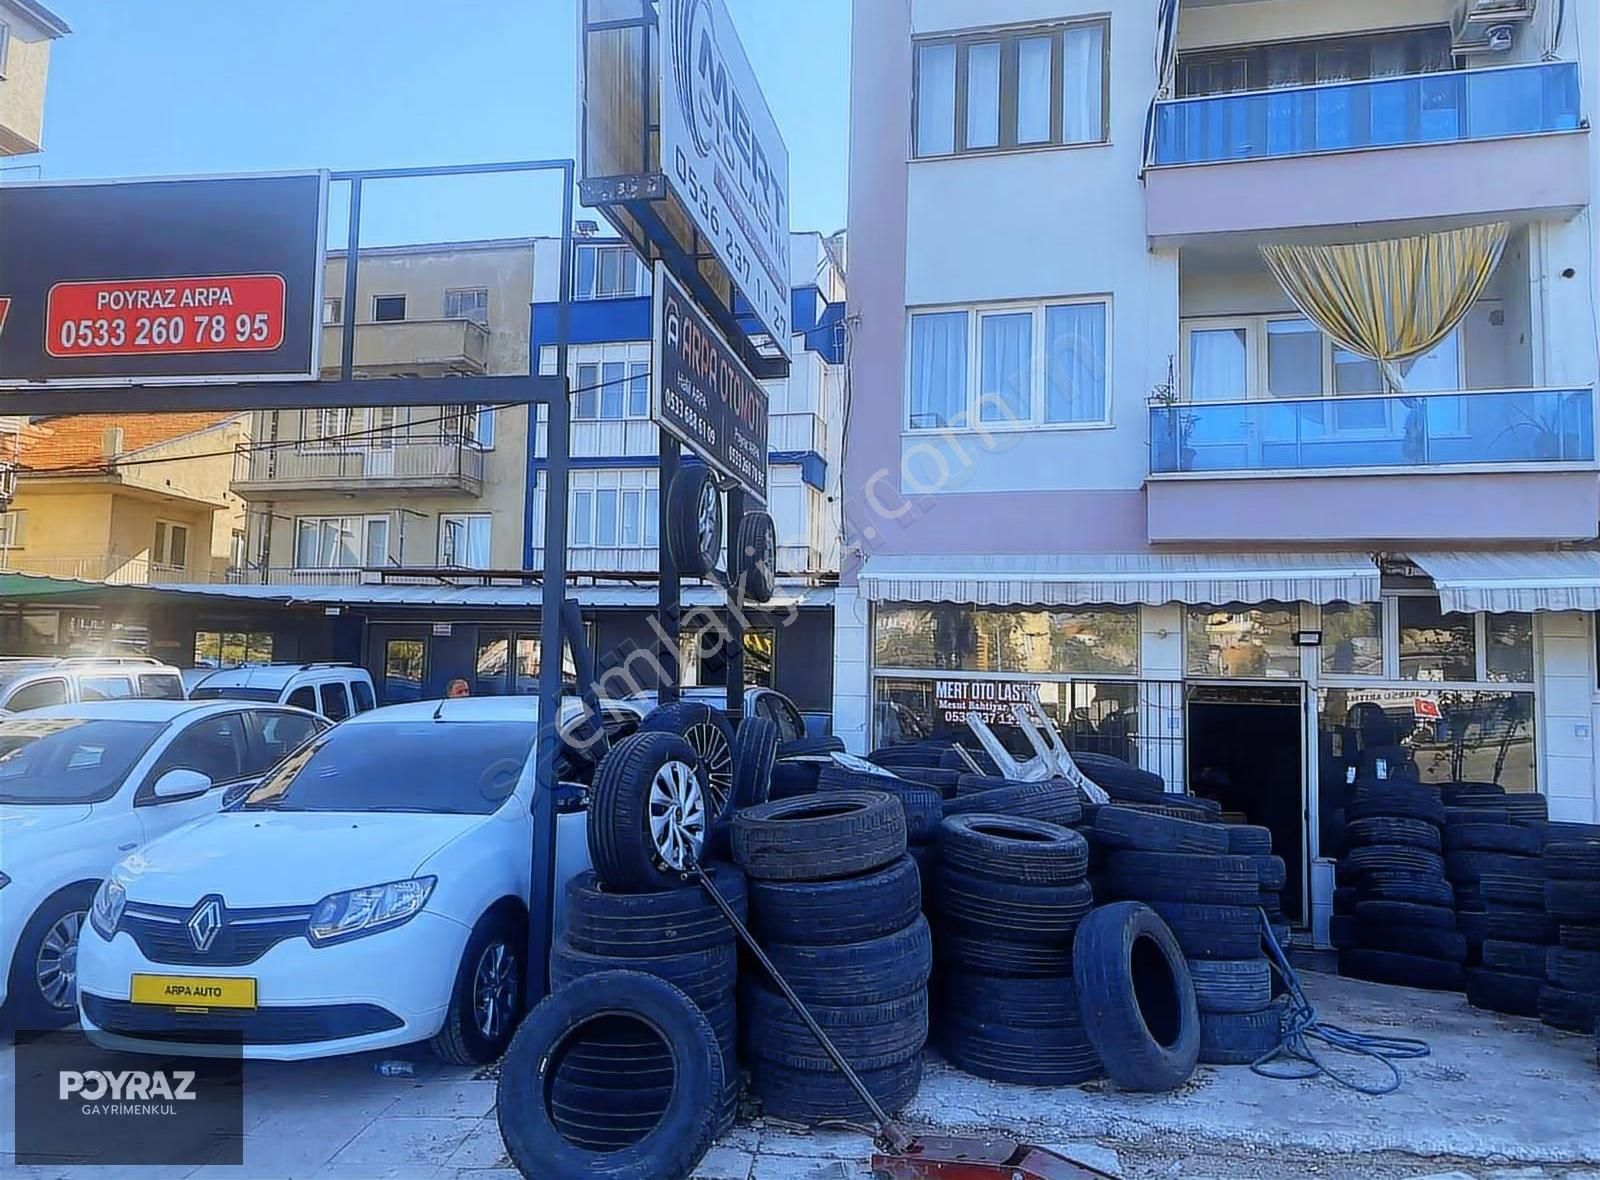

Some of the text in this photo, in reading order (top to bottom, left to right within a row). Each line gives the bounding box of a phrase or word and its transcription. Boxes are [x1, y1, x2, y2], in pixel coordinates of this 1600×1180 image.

[699, 27, 785, 227] MERT
[701, 83, 735, 173] OTO
[675, 144, 786, 340] 0536 237 11 27
[97, 286, 233, 311] POYRAZ ARPA
[61, 312, 269, 348] 0533 260 78 95
[682, 315, 718, 393] ARPA
[664, 387, 684, 419] 0533
[936, 681, 969, 699] MERT
[971, 682, 994, 700] OTO
[165, 985, 222, 997] ARPA AUTO
